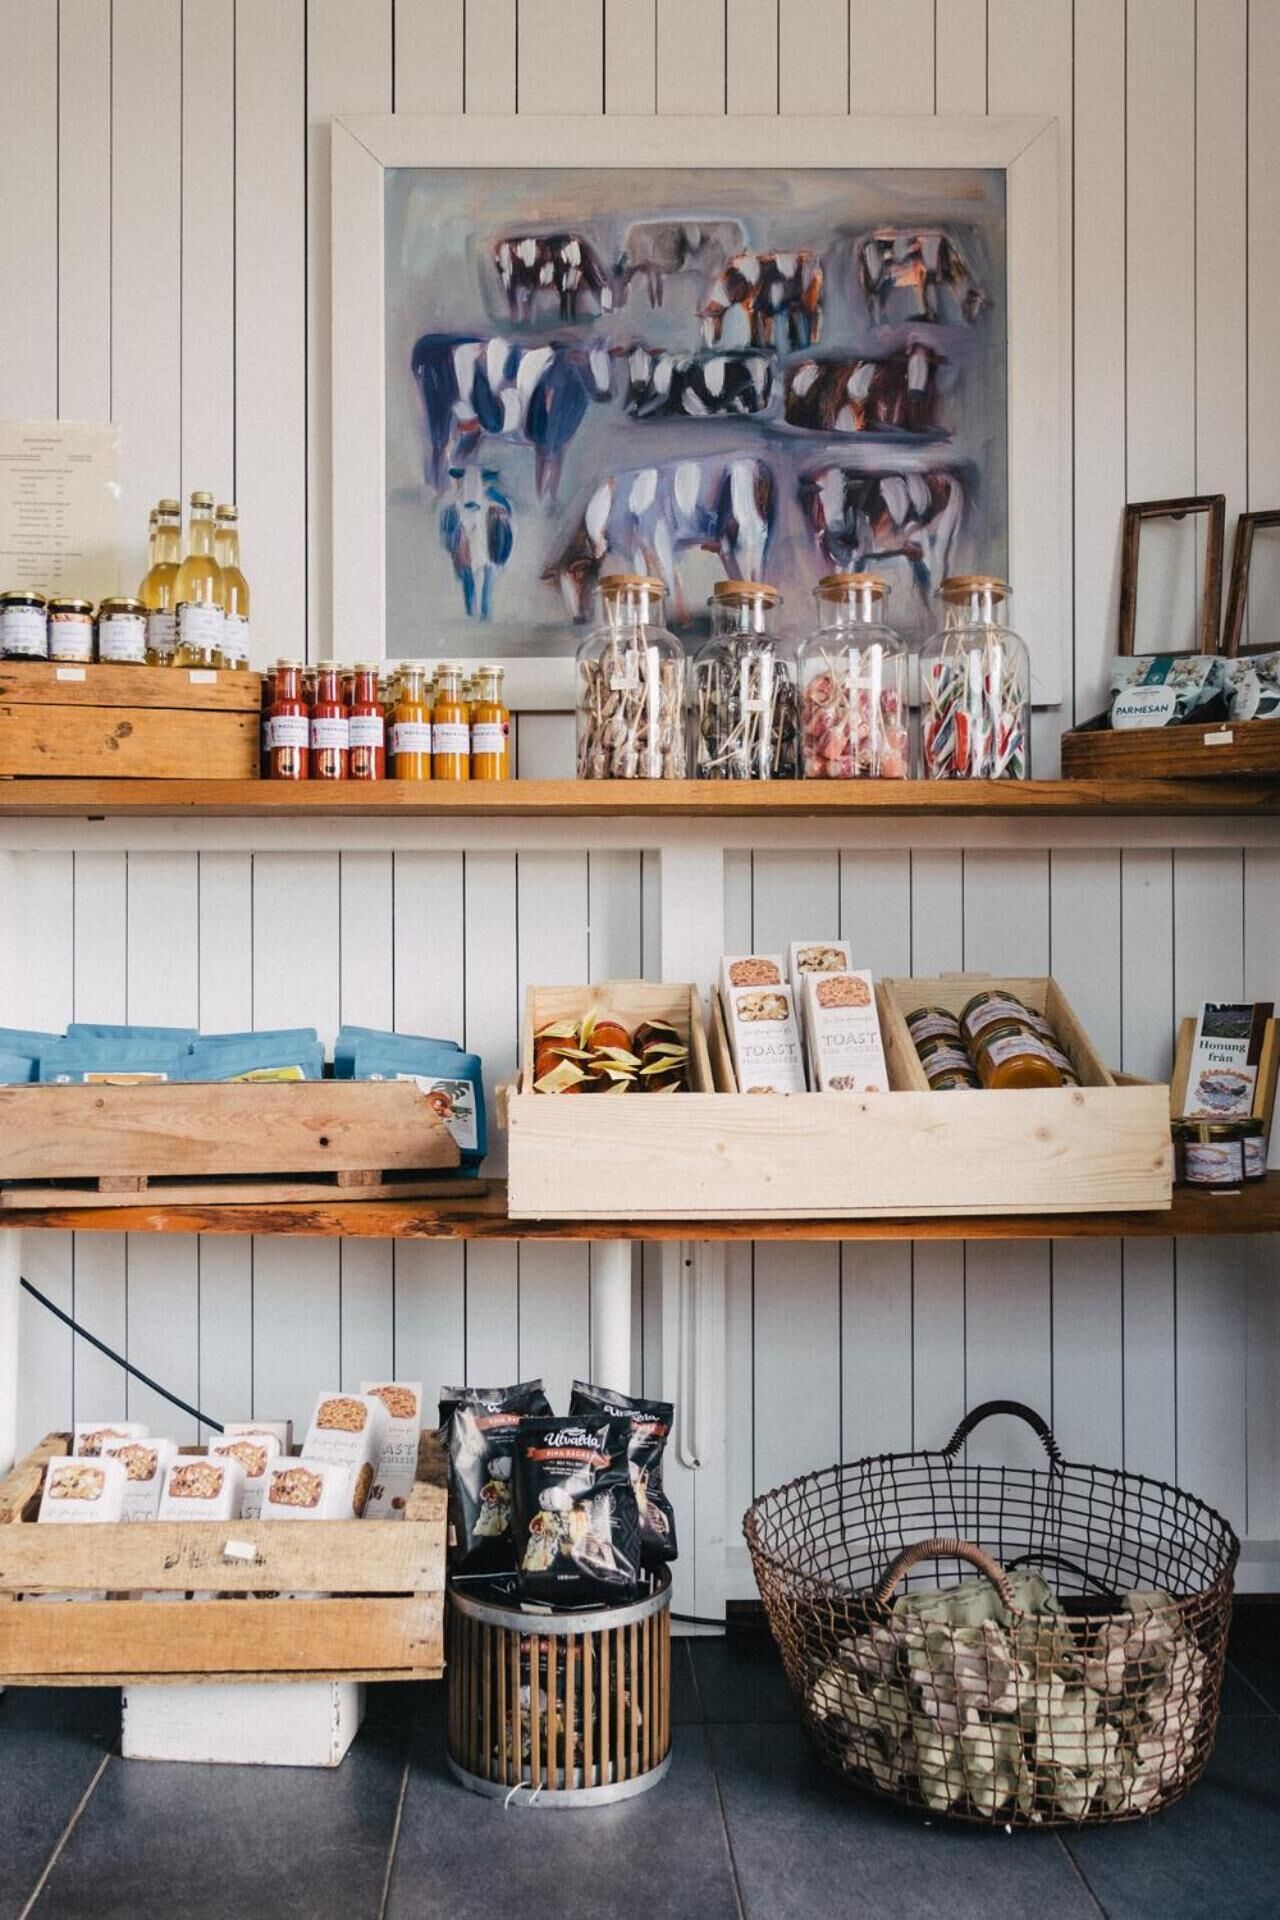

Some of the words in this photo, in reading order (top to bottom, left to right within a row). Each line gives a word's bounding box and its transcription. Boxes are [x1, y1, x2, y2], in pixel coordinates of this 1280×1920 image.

[1116, 704, 1168, 715] PARMESAN
[822, 1032, 878, 1046] TOAST
[742, 1043, 796, 1057] TOAST
[1199, 1040, 1246, 1053] Honung
[1208, 1052, 1233, 1063] från
[543, 1432, 600, 1448] Utvalda
